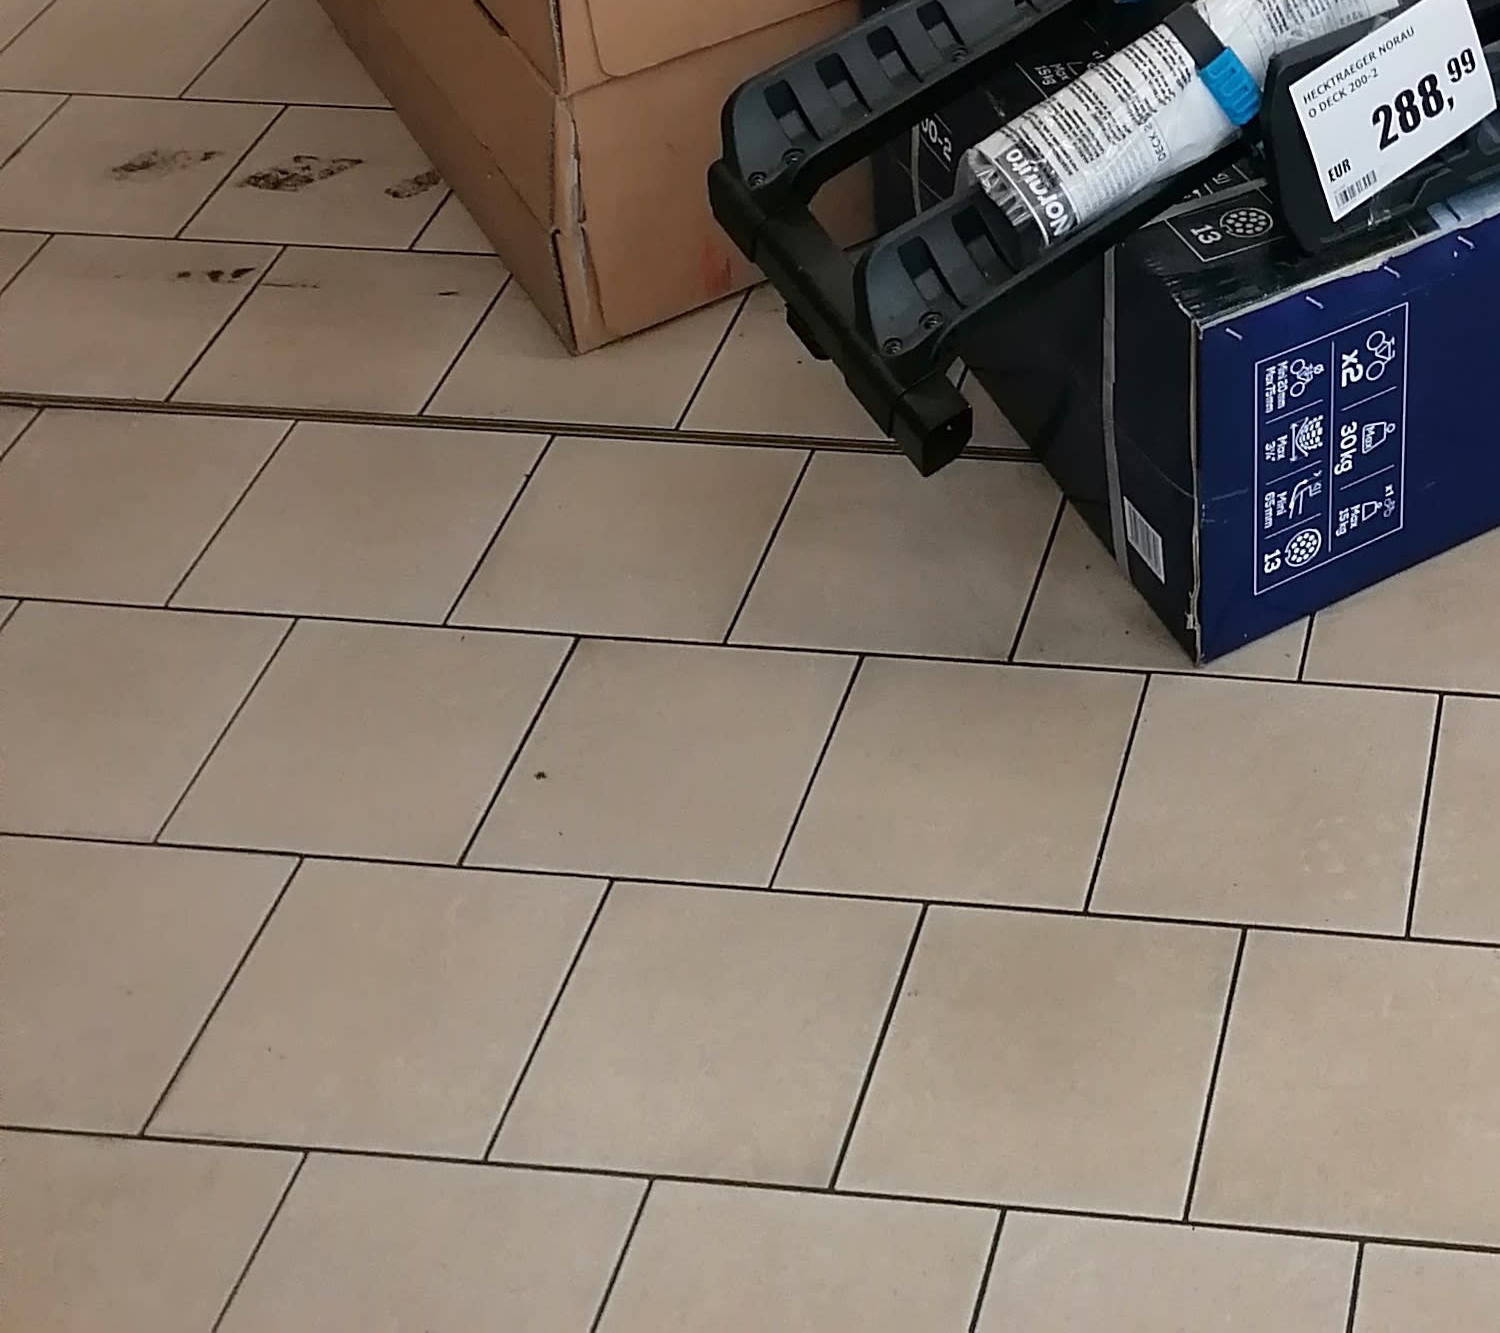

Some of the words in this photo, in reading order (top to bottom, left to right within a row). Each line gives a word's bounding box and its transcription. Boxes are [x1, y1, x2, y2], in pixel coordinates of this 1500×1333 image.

[1303, 50, 1378, 105] HECKTRAEGER
[1378, 26, 1416, 57] NORAU
[1318, 91, 1348, 112] DECK
[1349, 68, 1379, 93] 200-2
[1327, 158, 1352, 183] EUR
[1190, 224, 1222, 245] 13
[1341, 349, 1363, 387] x2
[1263, 549, 1282, 574] 13
